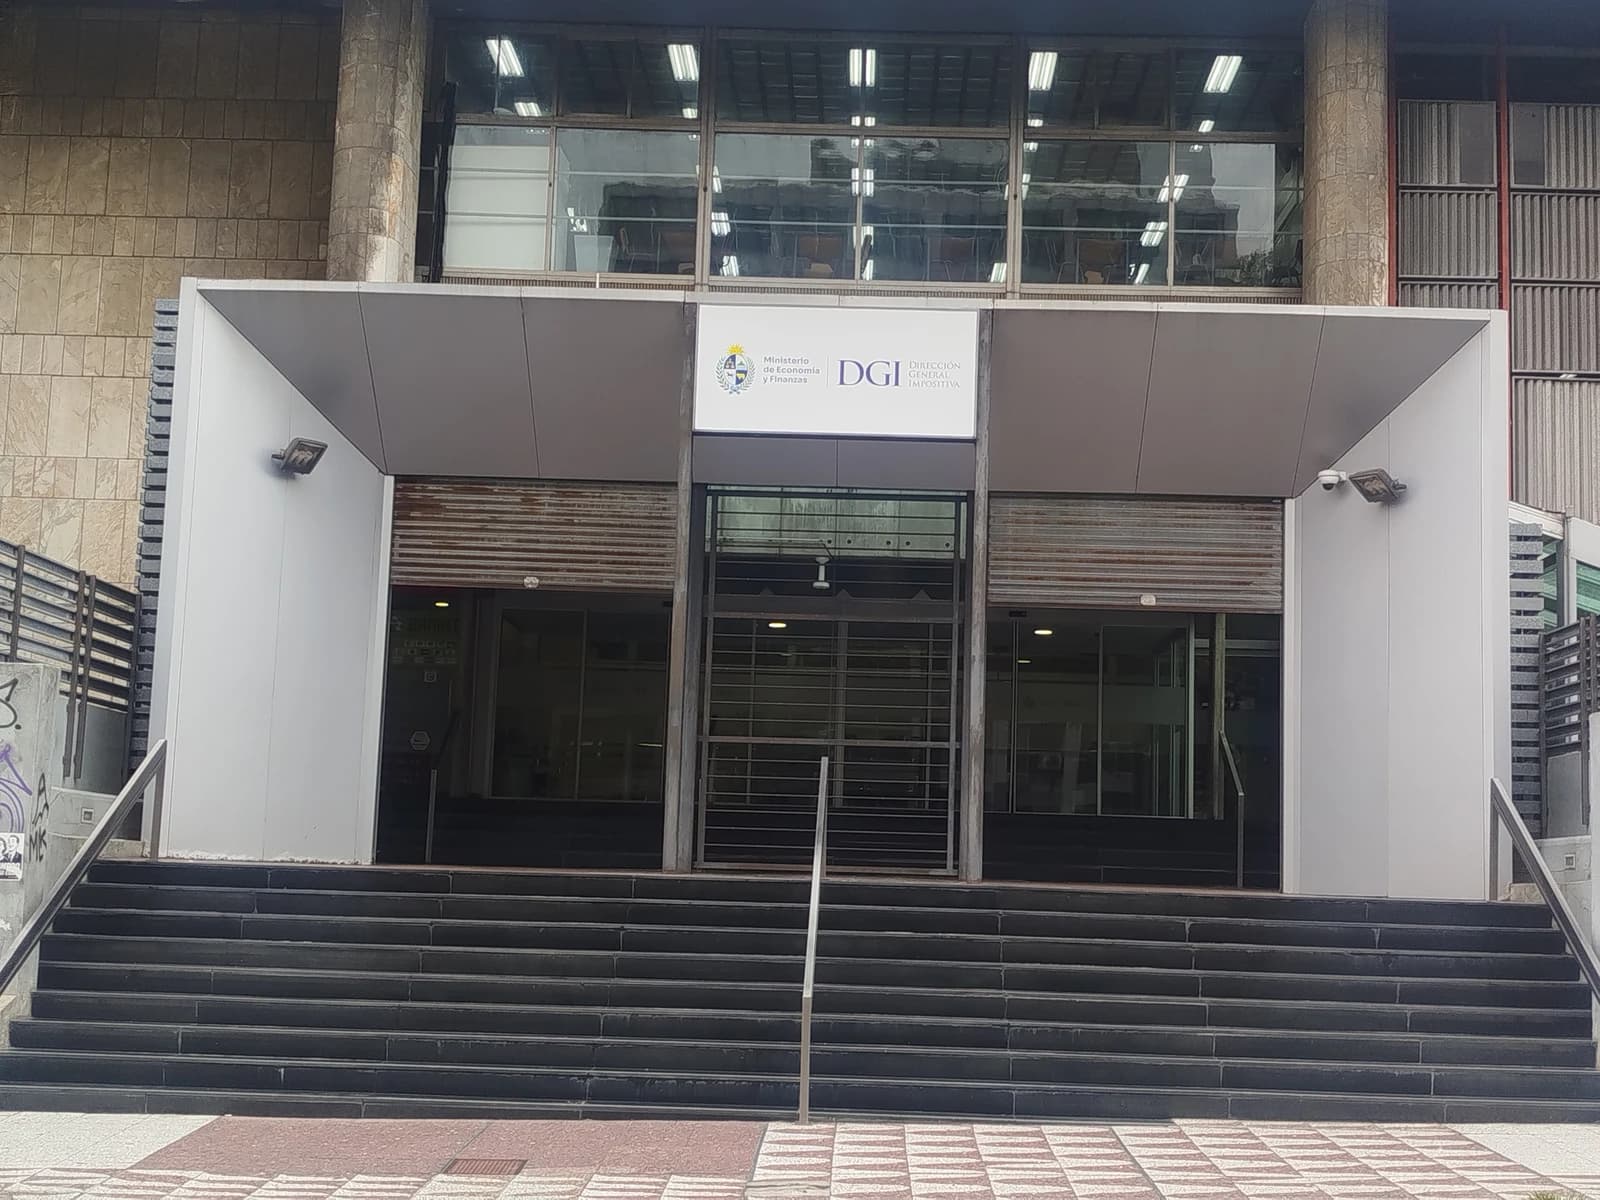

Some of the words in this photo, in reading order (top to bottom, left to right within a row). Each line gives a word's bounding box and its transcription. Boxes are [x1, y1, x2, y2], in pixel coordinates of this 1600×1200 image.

[763, 356, 809, 365] Ministerio
[763, 366, 775, 374] de
[837, 359, 901, 387] DGI
[908, 370, 950, 379] GENERAL
[769, 375, 808, 383] Finanzas
[908, 379, 961, 389] IMPOSITIVA
